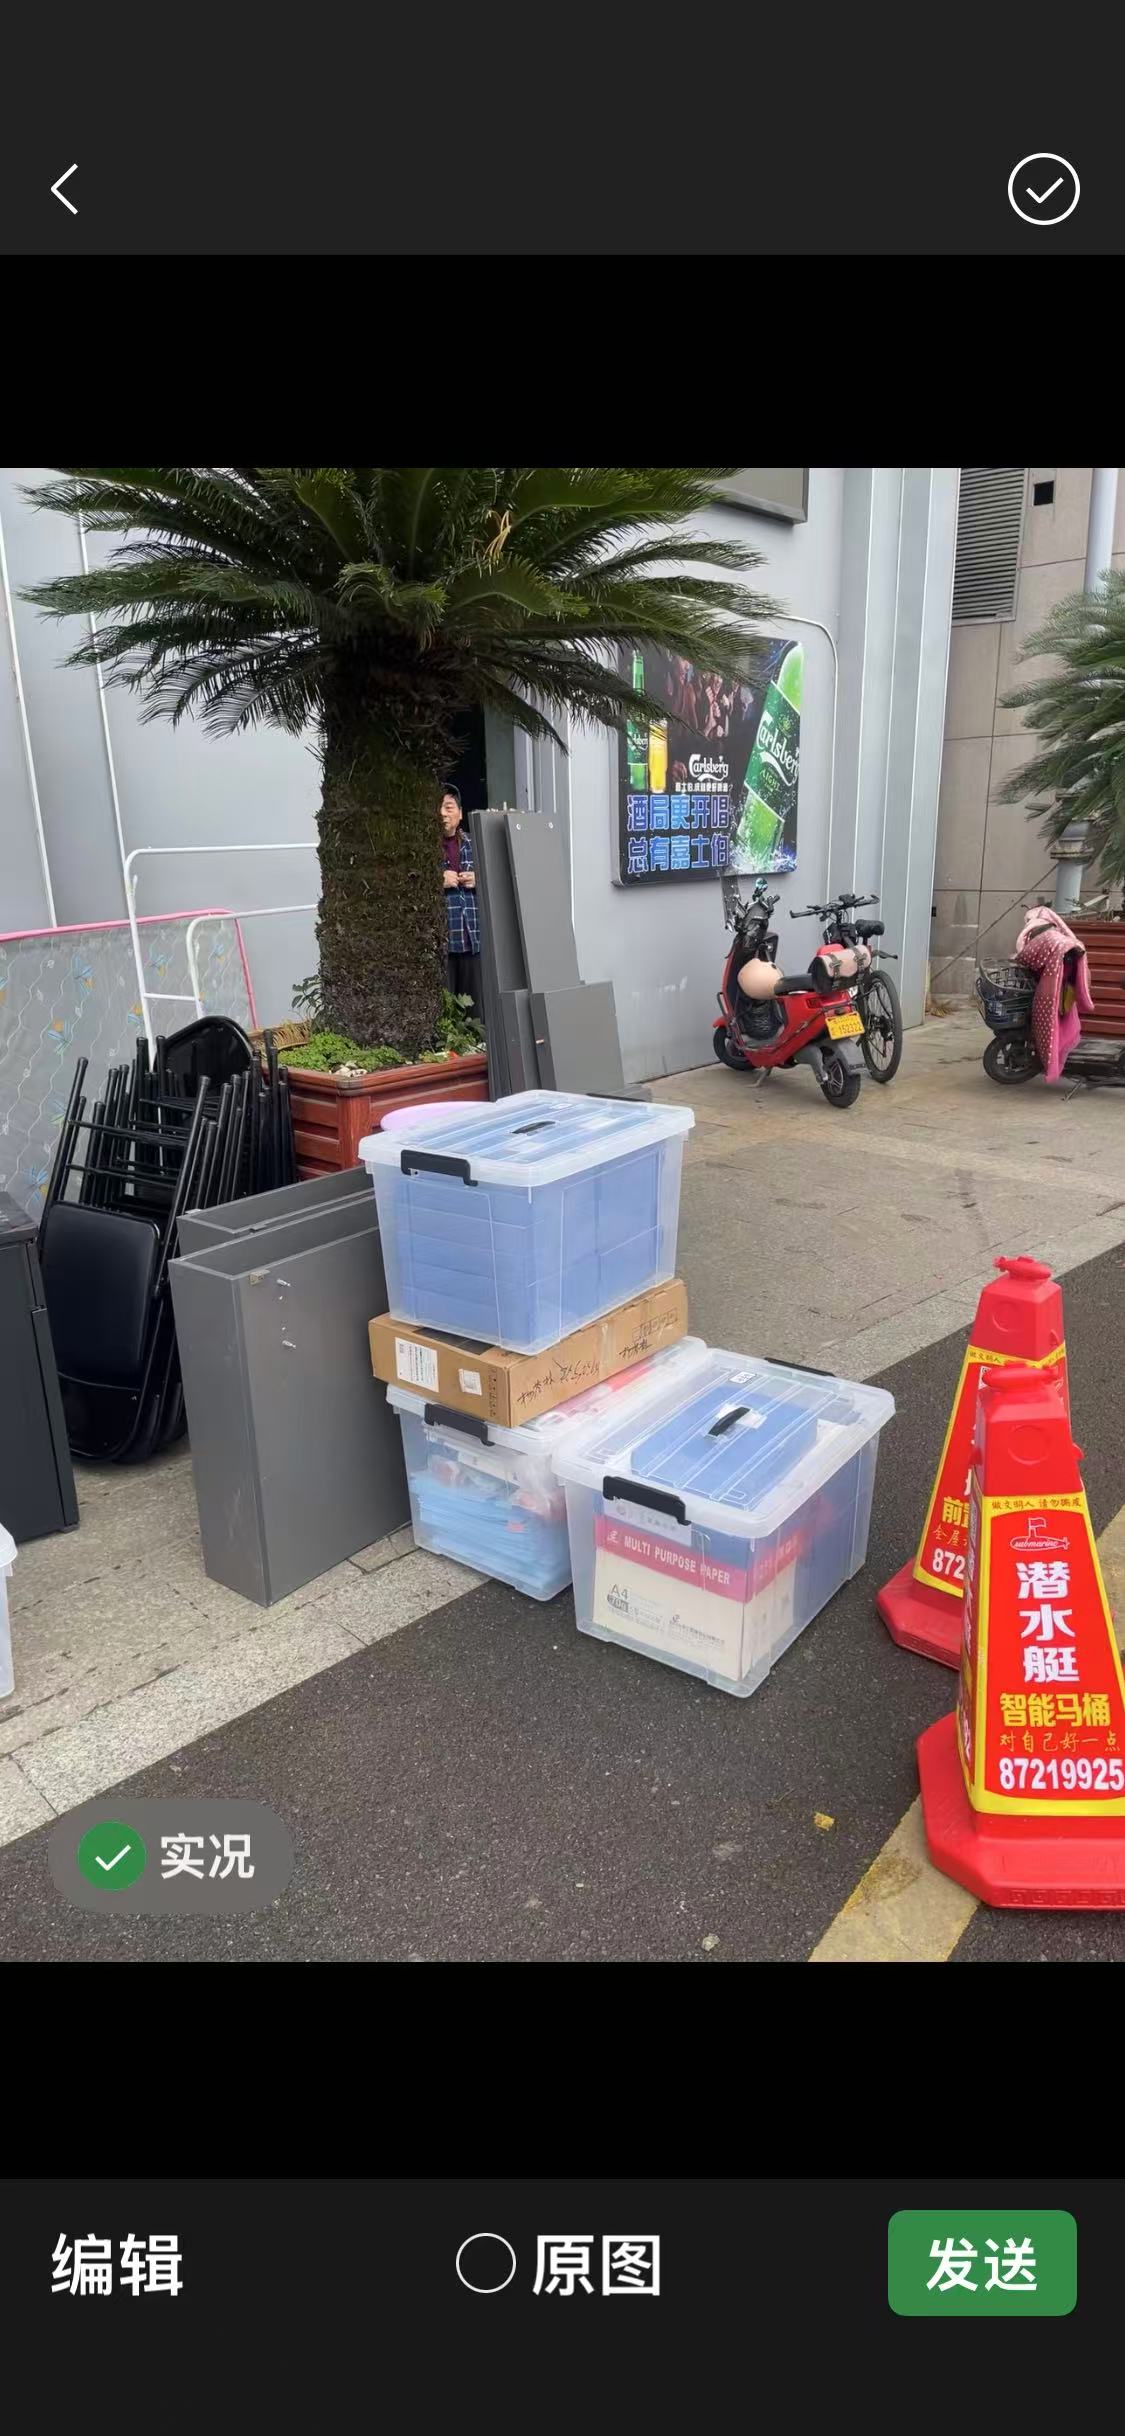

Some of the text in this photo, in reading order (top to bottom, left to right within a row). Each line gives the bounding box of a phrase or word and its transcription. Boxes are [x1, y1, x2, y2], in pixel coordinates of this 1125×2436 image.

[688, 754, 729, 778] Carlsberg
[627, 794, 729, 831] 酒局更开唱
[628, 833, 729, 873] 总有嘉士伯
[624, 1535, 730, 1585] MULTI PURPOSE PAPER
[1014, 1538, 1059, 1548] submarine
[611, 1584, 629, 1600] A4
[1016, 1561, 1080, 1683] 潜水艇
[1000, 1693, 1111, 1728] 智能马桶
[1000, 1730, 1121, 1754] 对自己好一点
[999, 1757, 1125, 1791] 87219925
